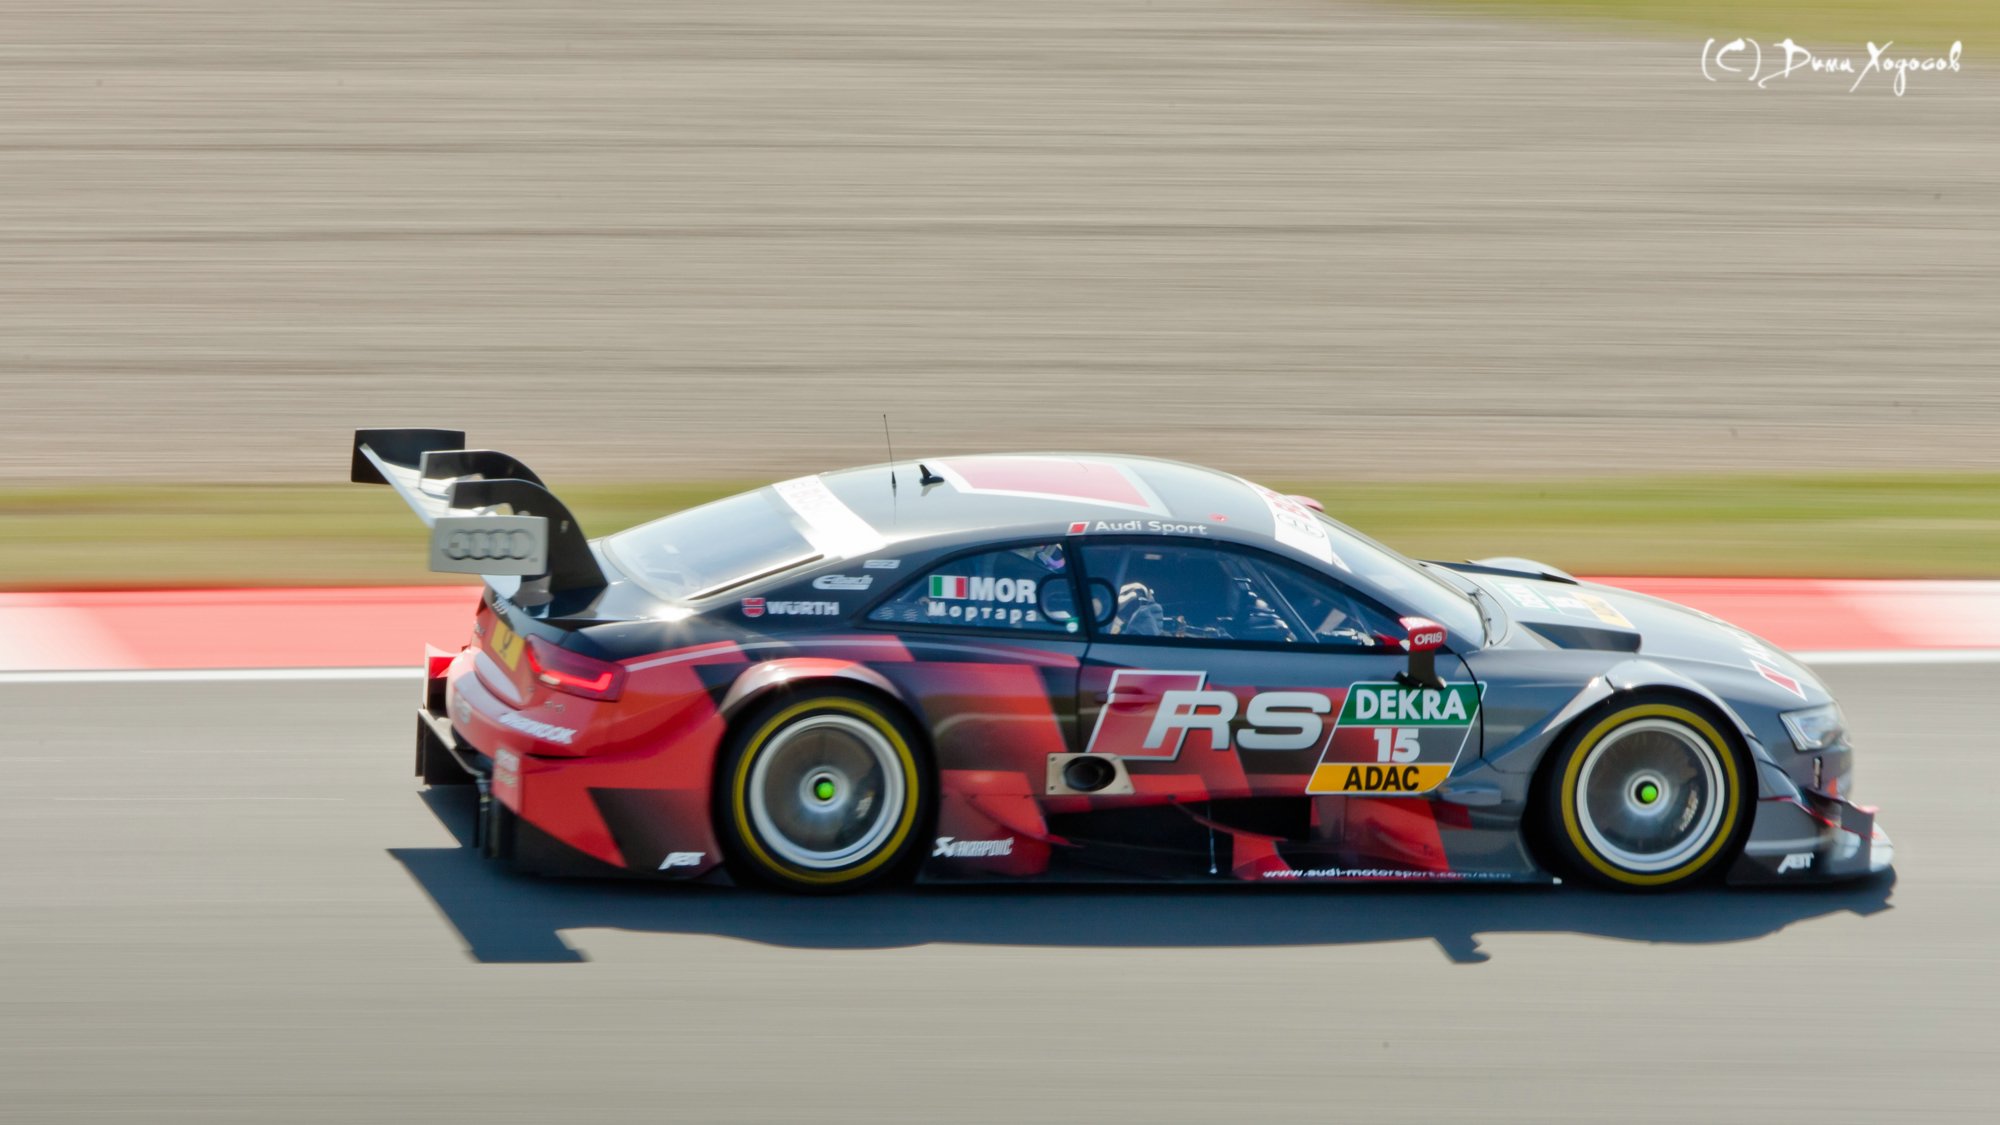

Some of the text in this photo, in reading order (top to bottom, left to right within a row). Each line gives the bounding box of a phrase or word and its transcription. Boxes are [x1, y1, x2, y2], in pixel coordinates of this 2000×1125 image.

[1094, 520, 1208, 536] Audi Sport
[969, 576, 1037, 604] MOR
[927, 601, 1037, 625] Мортара
[1414, 631, 1443, 646] ORIS
[1355, 688, 1468, 721] DEKRA
[1142, 690, 1333, 752] RS
[1373, 728, 1421, 763] 15
[1342, 766, 1420, 792] ADAC
[1777, 852, 1815, 874] ABT
